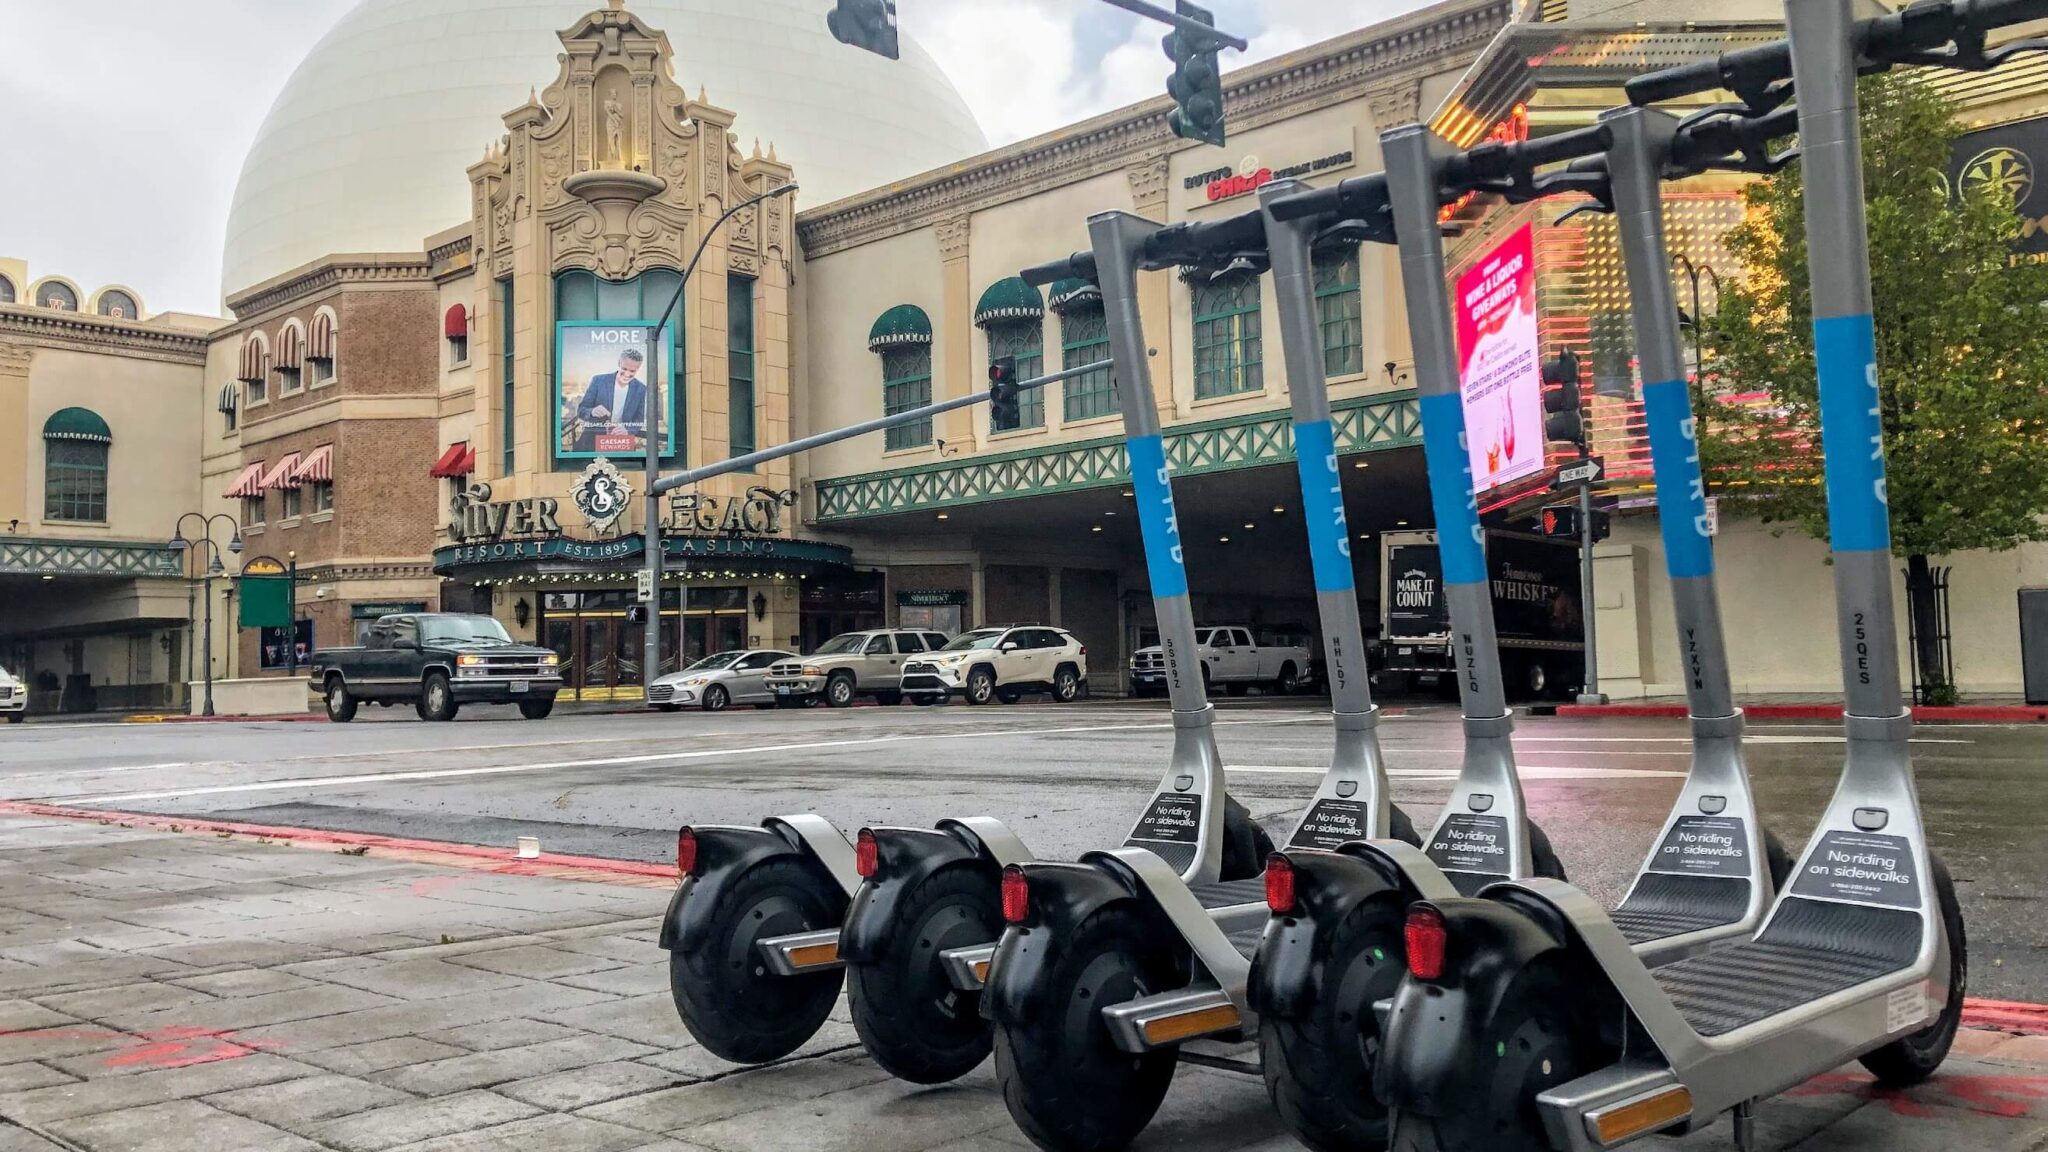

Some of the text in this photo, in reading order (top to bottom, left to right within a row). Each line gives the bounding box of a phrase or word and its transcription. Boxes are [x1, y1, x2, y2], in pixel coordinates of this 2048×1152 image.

[1312, 151, 1353, 169] HOUSE
[1207, 167, 1272, 201] CHRIS
[1465, 281, 1486, 309] WINE
[1493, 253, 1523, 288] LIQUOR
[1471, 278, 1517, 322] GIVEAWAYS
[591, 330, 640, 343] MORE
[1560, 467, 1589, 481] ONE WAY
[455, 539, 774, 560] RESORT EST. 1895 CASINO
[640, 571, 651, 579] ONE
[1396, 579, 1435, 592] MAKE IT
[1493, 580, 1559, 601] WHISKEY
[1396, 591, 1435, 607] COUNT
[1854, 612, 1870, 685] 25QES
[1156, 805, 1191, 818] No riding
[1156, 816, 1196, 827] sidewalks
[1316, 813, 1357, 827] No riding
[1317, 823, 1362, 836] sidewalks
[1448, 829, 1496, 844] No riding
[1679, 832, 1733, 847] No riding
[1433, 841, 1505, 855] on sidewalks
[1683, 845, 1743, 857] sidewalks
[1828, 850, 1896, 870] No riding
[1809, 865, 1910, 884] on sidewalks
